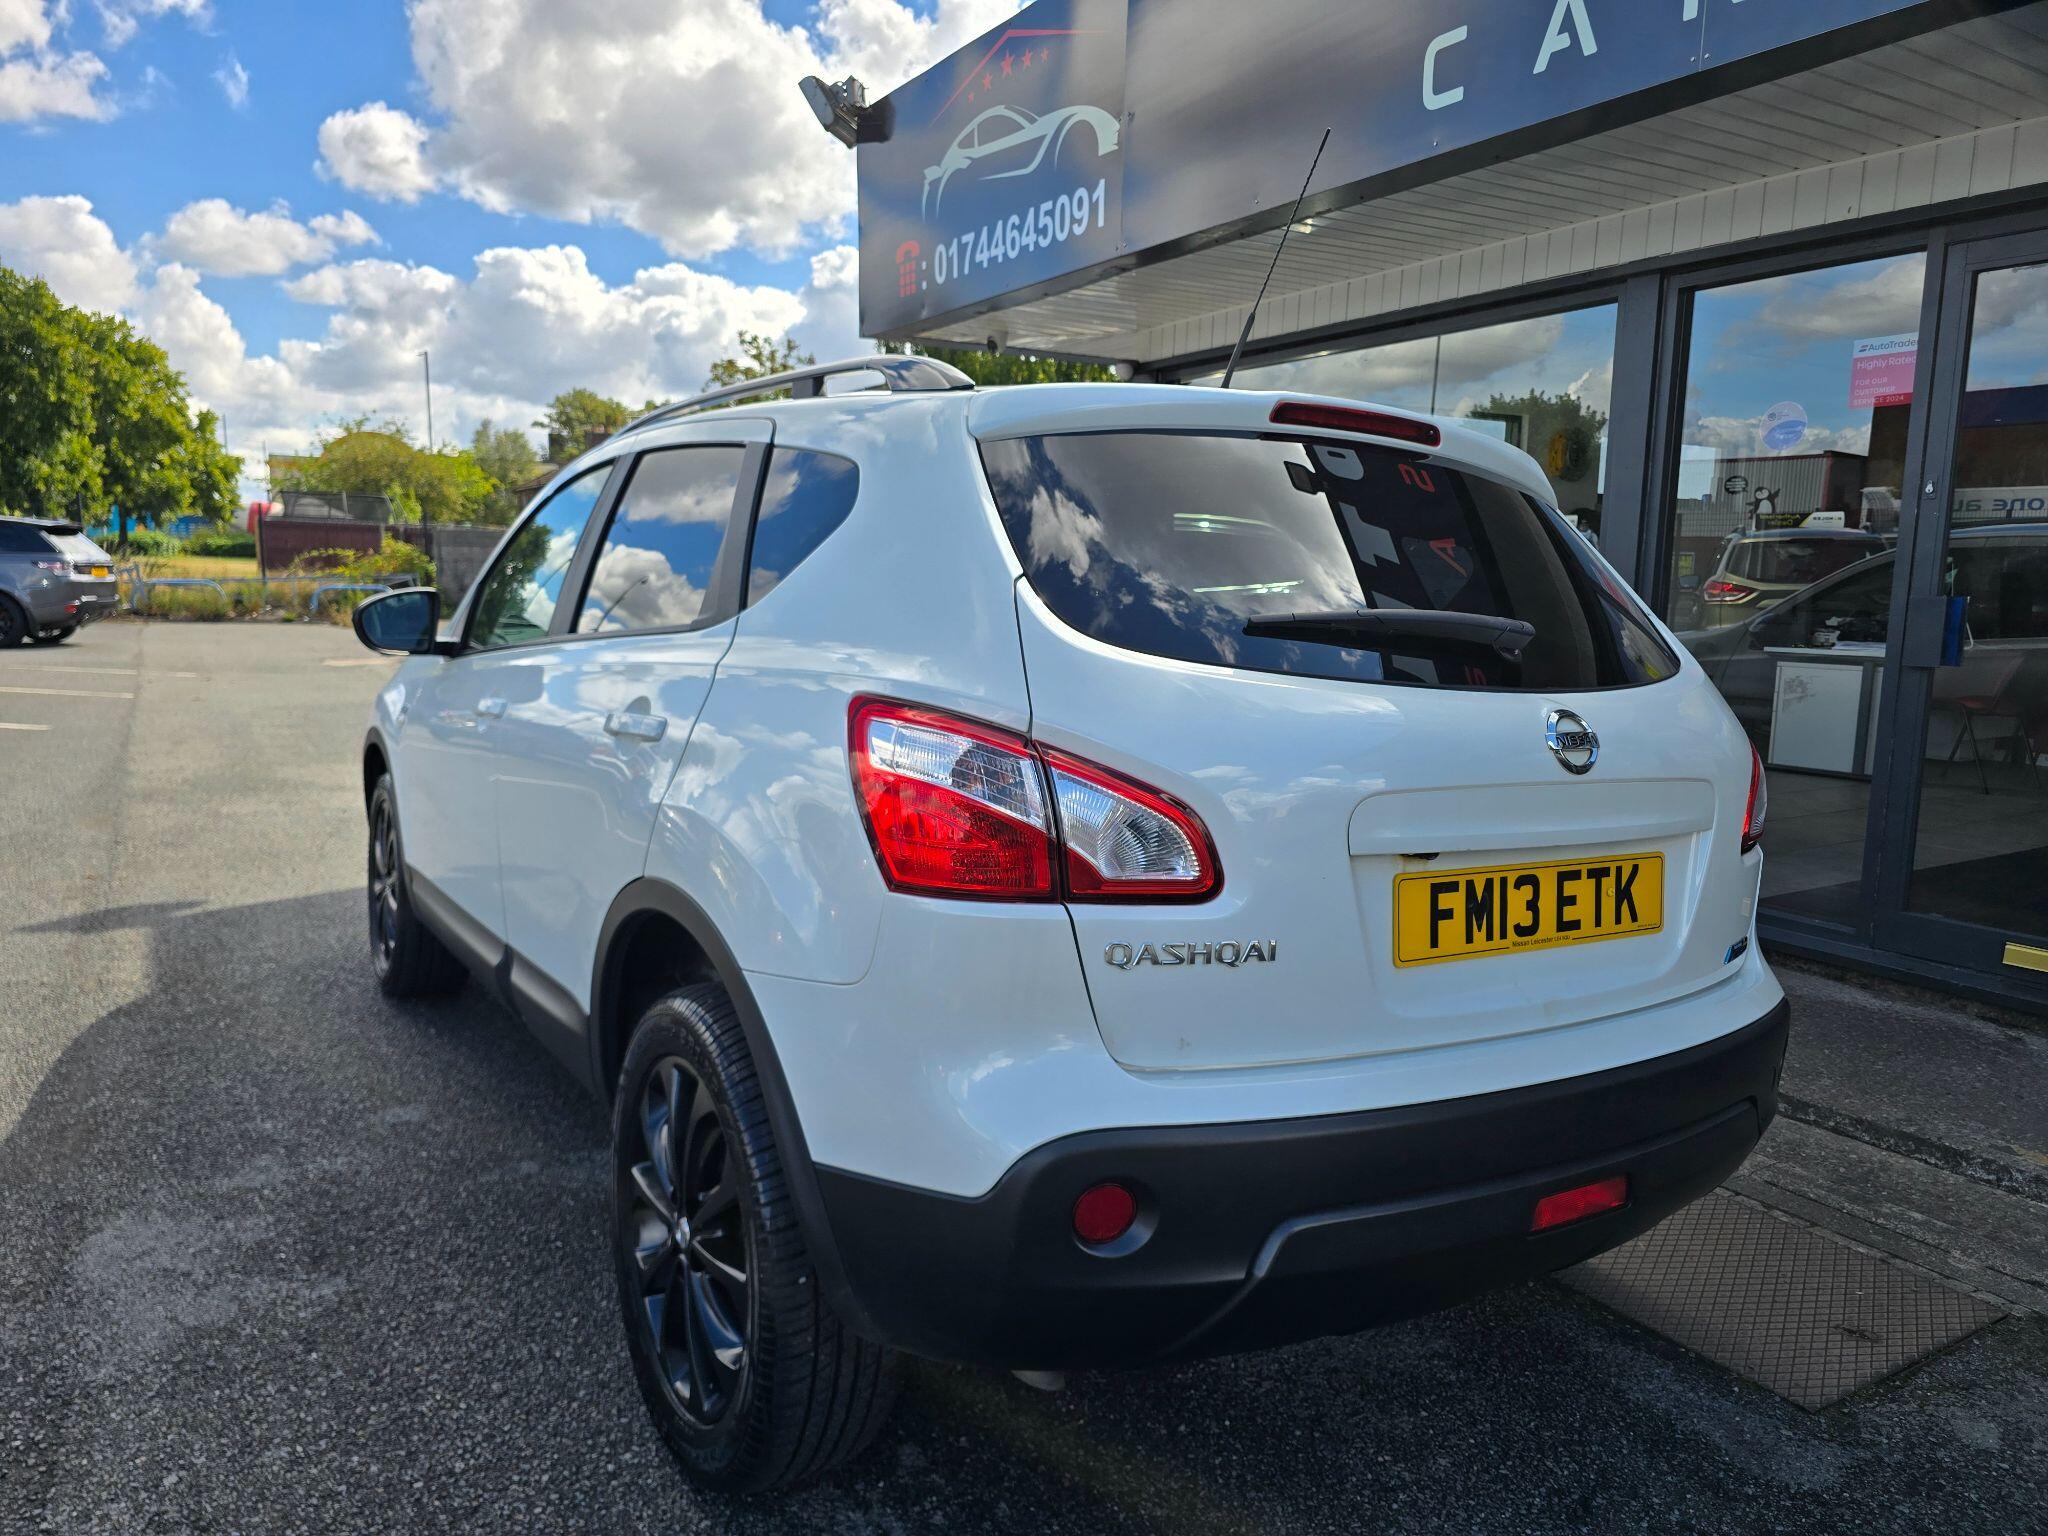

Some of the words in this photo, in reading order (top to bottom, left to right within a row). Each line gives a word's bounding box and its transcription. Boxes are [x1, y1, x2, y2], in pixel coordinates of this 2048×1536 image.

[934, 178, 1106, 285] 01744645091
[1857, 358, 1887, 370] Highly
[1855, 378, 1869, 386] FOR
[1871, 376, 1888, 385] OUR
[1854, 384, 1896, 396] CUSTOMER
[1853, 396, 1885, 406] SERVICE
[1886, 394, 1904, 402] 2024
[1556, 734, 1598, 749] NISSAN
[1430, 873, 1541, 949] FM13
[1556, 863, 1639, 933] ETK
[1512, 938, 1530, 948] Nissan
[1531, 935, 1553, 946] Leicester
[1104, 939, 1276, 971] QASHQAI
